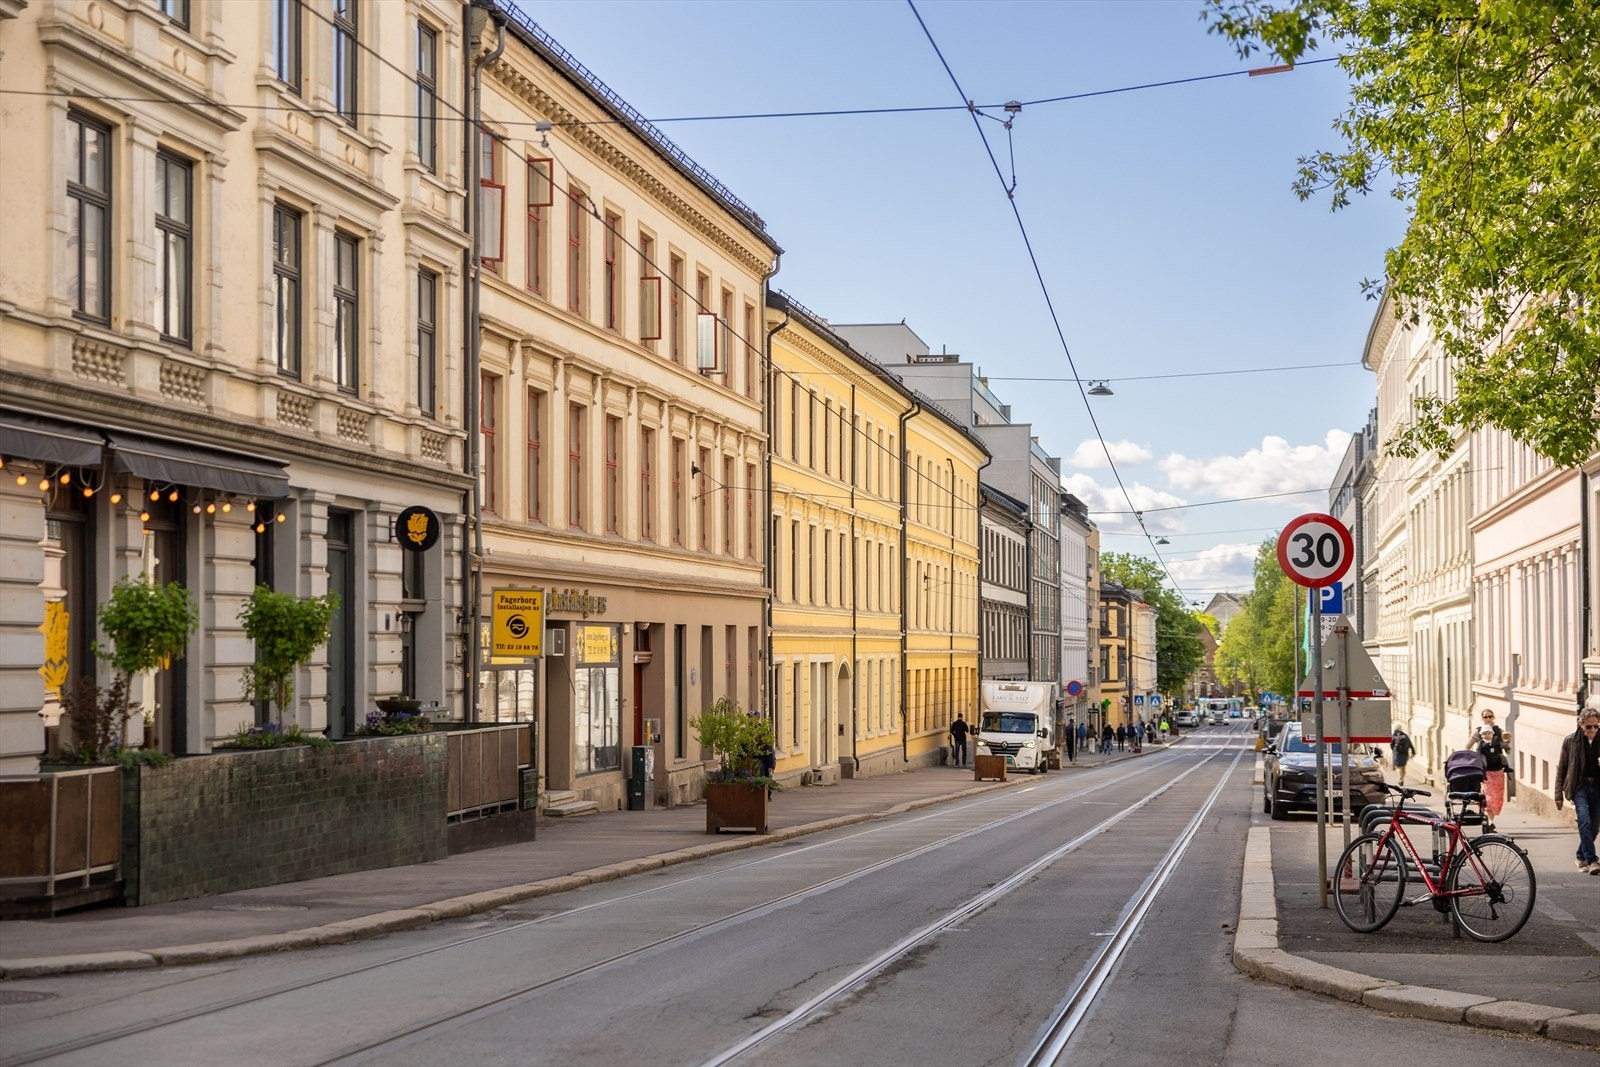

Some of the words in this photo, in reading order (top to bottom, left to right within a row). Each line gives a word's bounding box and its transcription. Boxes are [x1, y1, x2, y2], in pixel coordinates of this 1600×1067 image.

[1291, 532, 1340, 569] 30
[500, 595, 537, 605] Fagerborg
[1319, 585, 1335, 611] P
